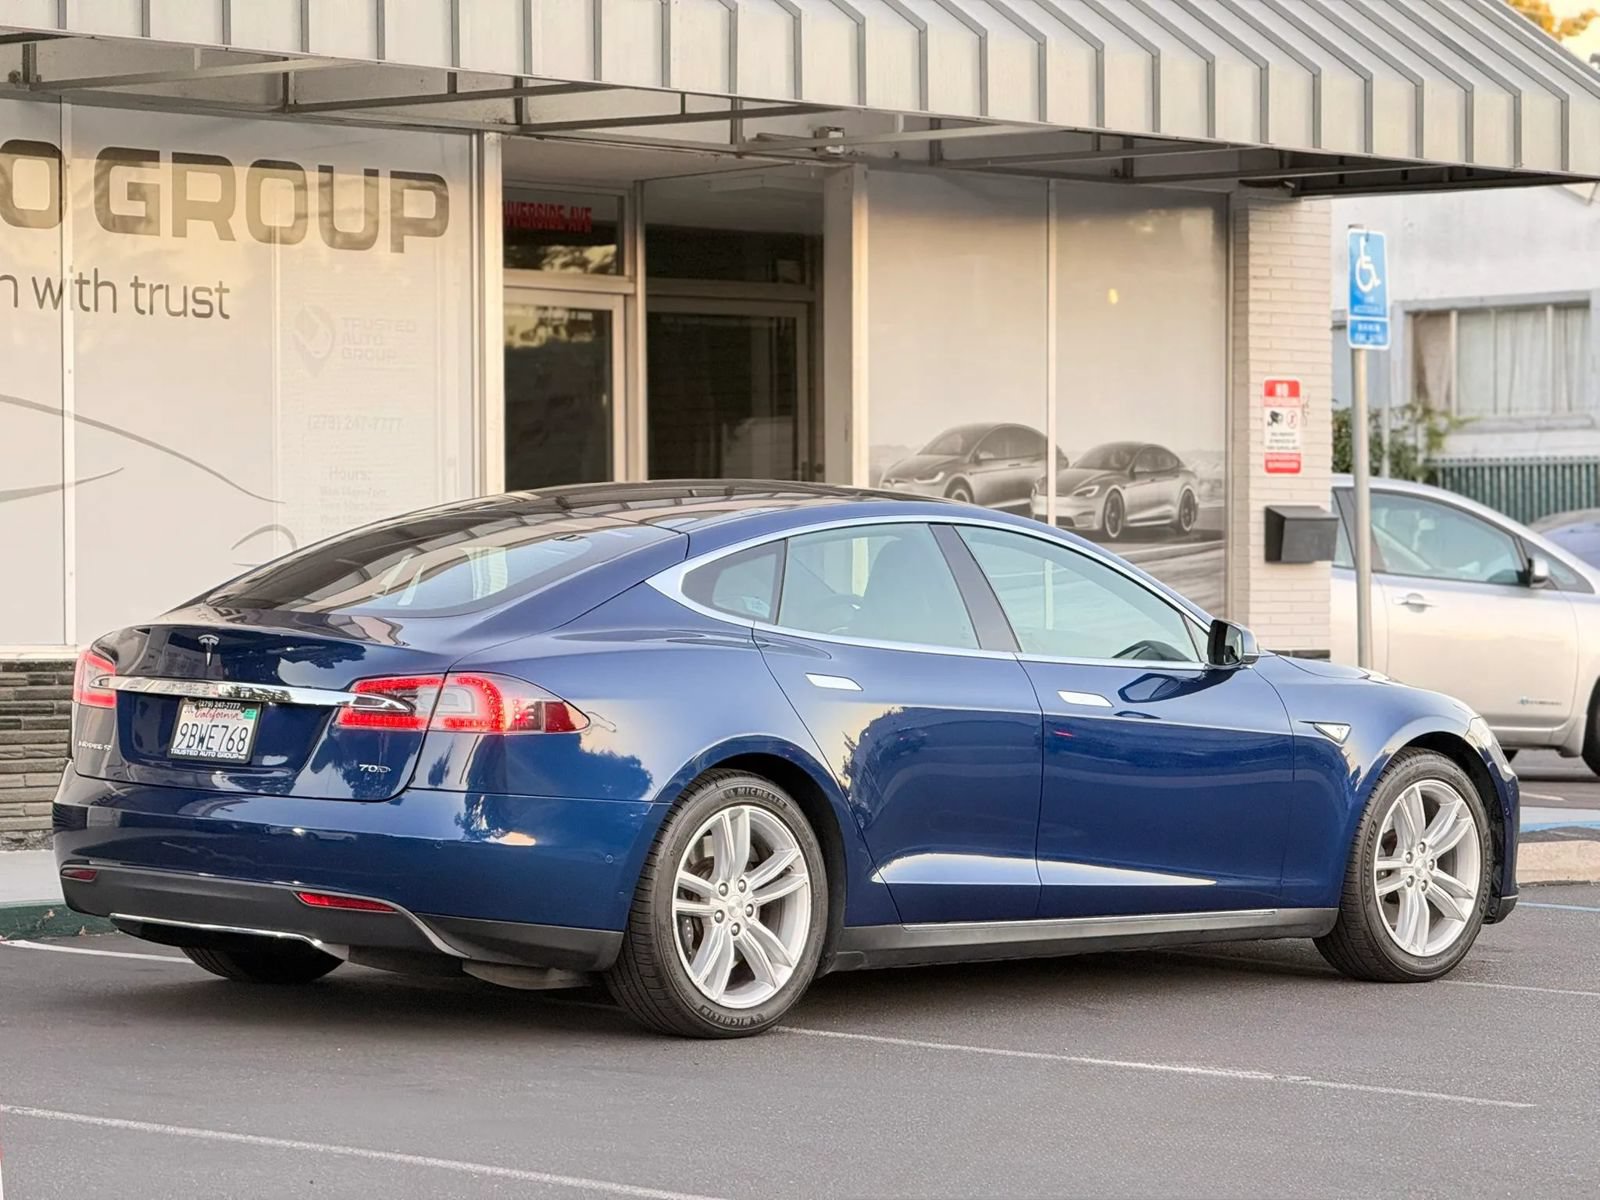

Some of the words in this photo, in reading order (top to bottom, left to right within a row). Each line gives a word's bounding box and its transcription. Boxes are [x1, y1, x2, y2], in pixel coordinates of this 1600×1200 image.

[93, 146, 450, 254] GROUP
[504, 201, 565, 230] IVERSIDE
[130, 275, 230, 320] trust
[341, 317, 417, 333] TRUSTED
[342, 347, 398, 361] GROUP
[194, 708, 243, 723] California
[175, 722, 249, 753] 9BWE768
[171, 748, 198, 757] TRUSTED
[199, 749, 216, 758] AUTO
[217, 751, 239, 760] GROUP
[359, 764, 391, 773] 70D
[737, 786, 787, 809] MICHELIN
